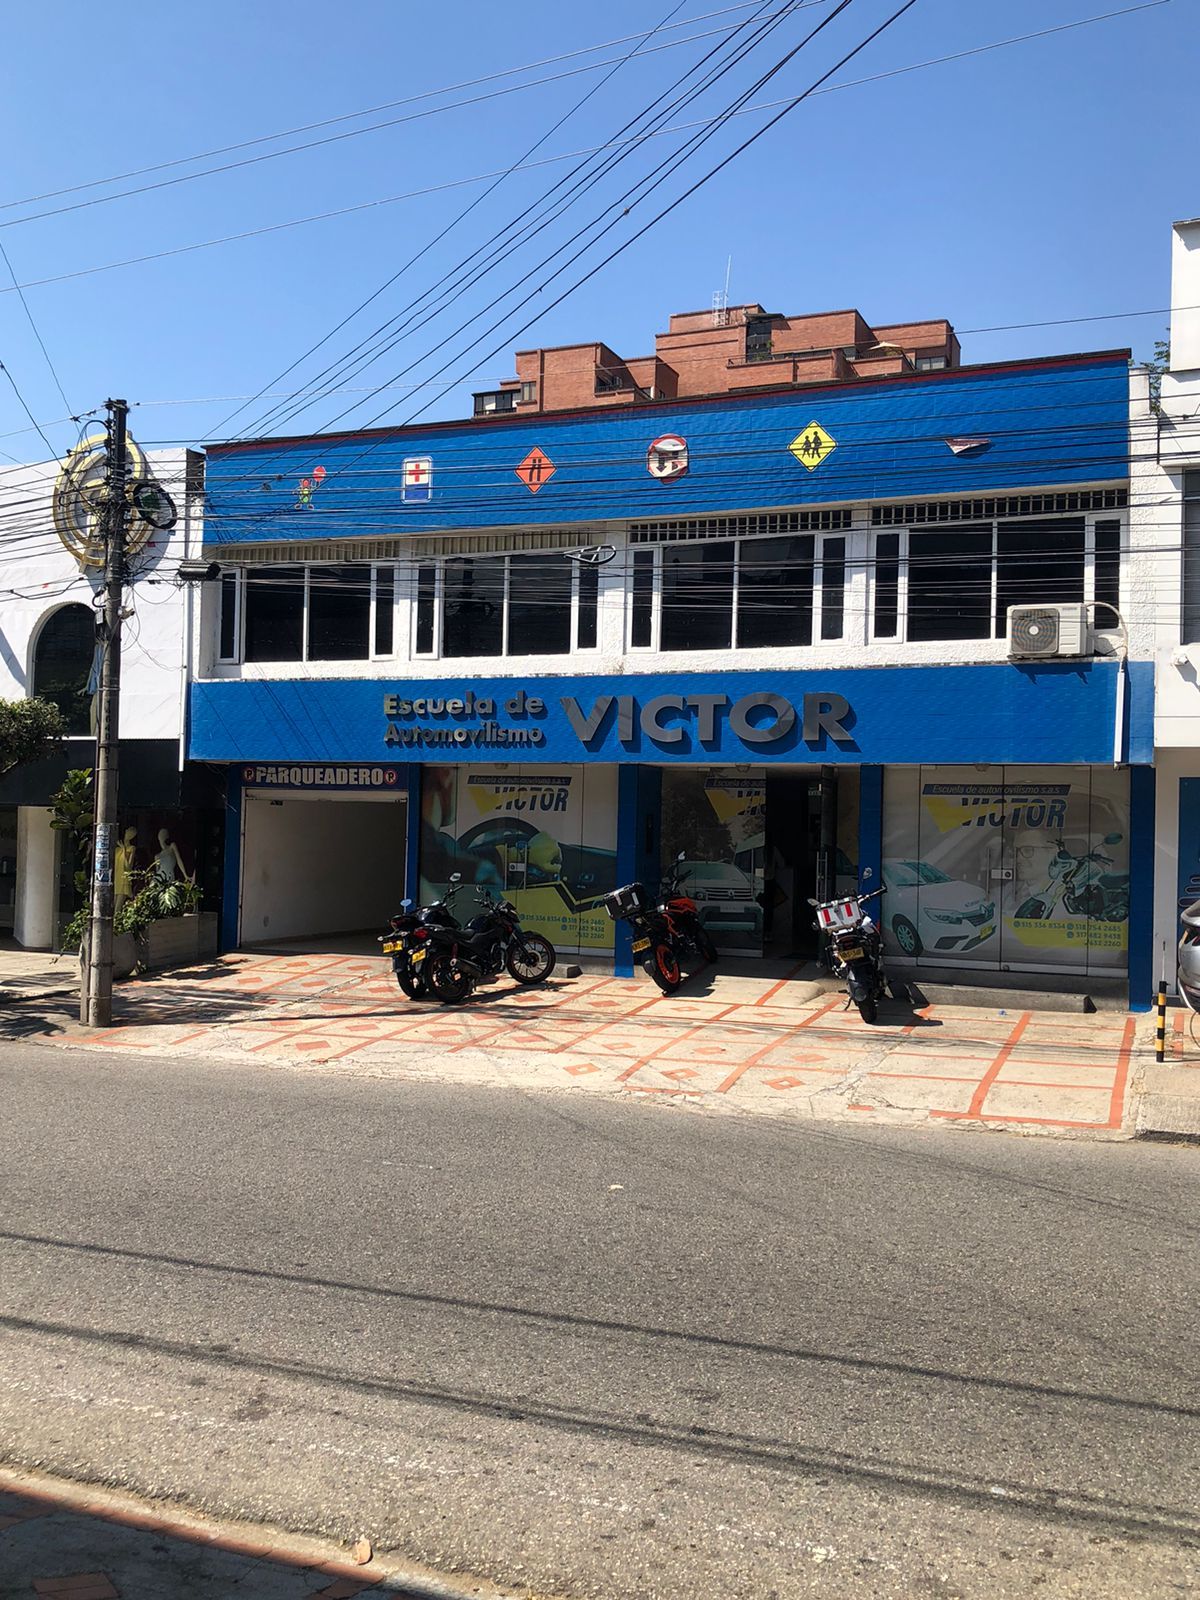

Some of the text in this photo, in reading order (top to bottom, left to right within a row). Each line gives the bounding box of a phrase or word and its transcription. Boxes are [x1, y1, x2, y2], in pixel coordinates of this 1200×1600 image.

[384, 690, 544, 715] Escuela de
[560, 691, 855, 743] VICTOR
[384, 720, 543, 743] Automovilismo
[255, 766, 384, 786] PARQUEADERO
[495, 786, 570, 812] VICTOR
[932, 785, 965, 793] Escuela
[966, 785, 977, 793] de
[961, 797, 1067, 828] VICTOR
